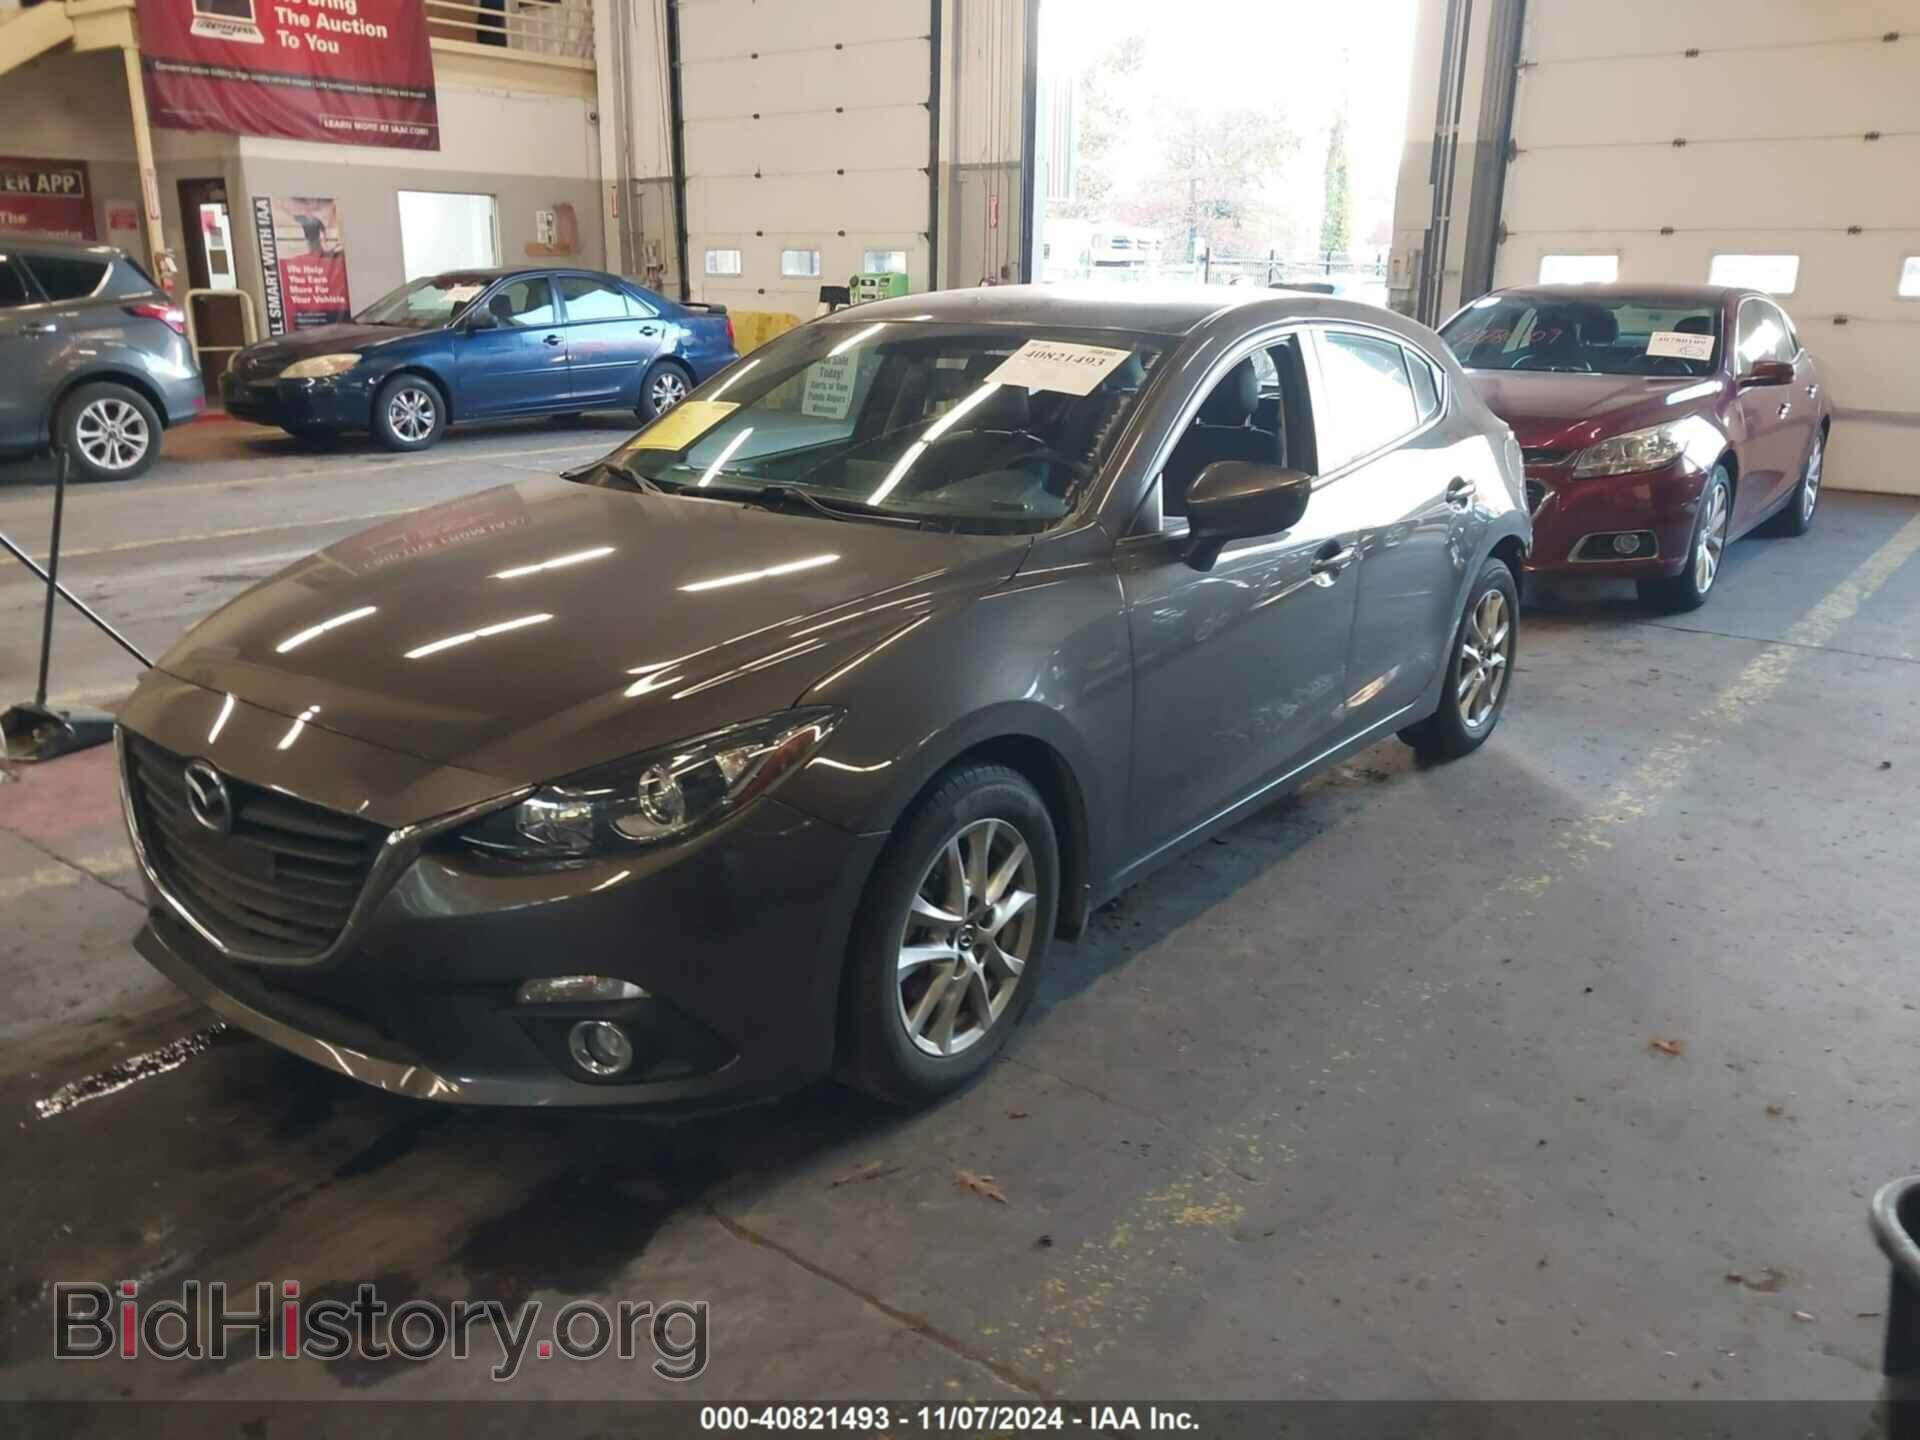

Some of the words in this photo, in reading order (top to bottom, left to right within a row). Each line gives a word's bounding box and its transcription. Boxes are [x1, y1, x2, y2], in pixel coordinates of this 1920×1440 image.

[274, 6, 311, 28] The
[316, 12, 388, 39] Auction
[276, 29, 300, 49] To
[304, 32, 340, 54] You
[0, 174, 31, 192] ER
[36, 173, 76, 193] APP
[256, 199, 271, 225] IAA
[260, 227, 275, 266] WITH
[287, 265, 301, 274] We
[303, 265, 324, 275] Help
[288, 275, 305, 284] You
[308, 275, 328, 284] Earn
[264, 268, 282, 318] SMART
[291, 295, 311, 304] Your
[313, 295, 345, 304] Vehicle
[1024, 349, 1107, 367] 40821493
